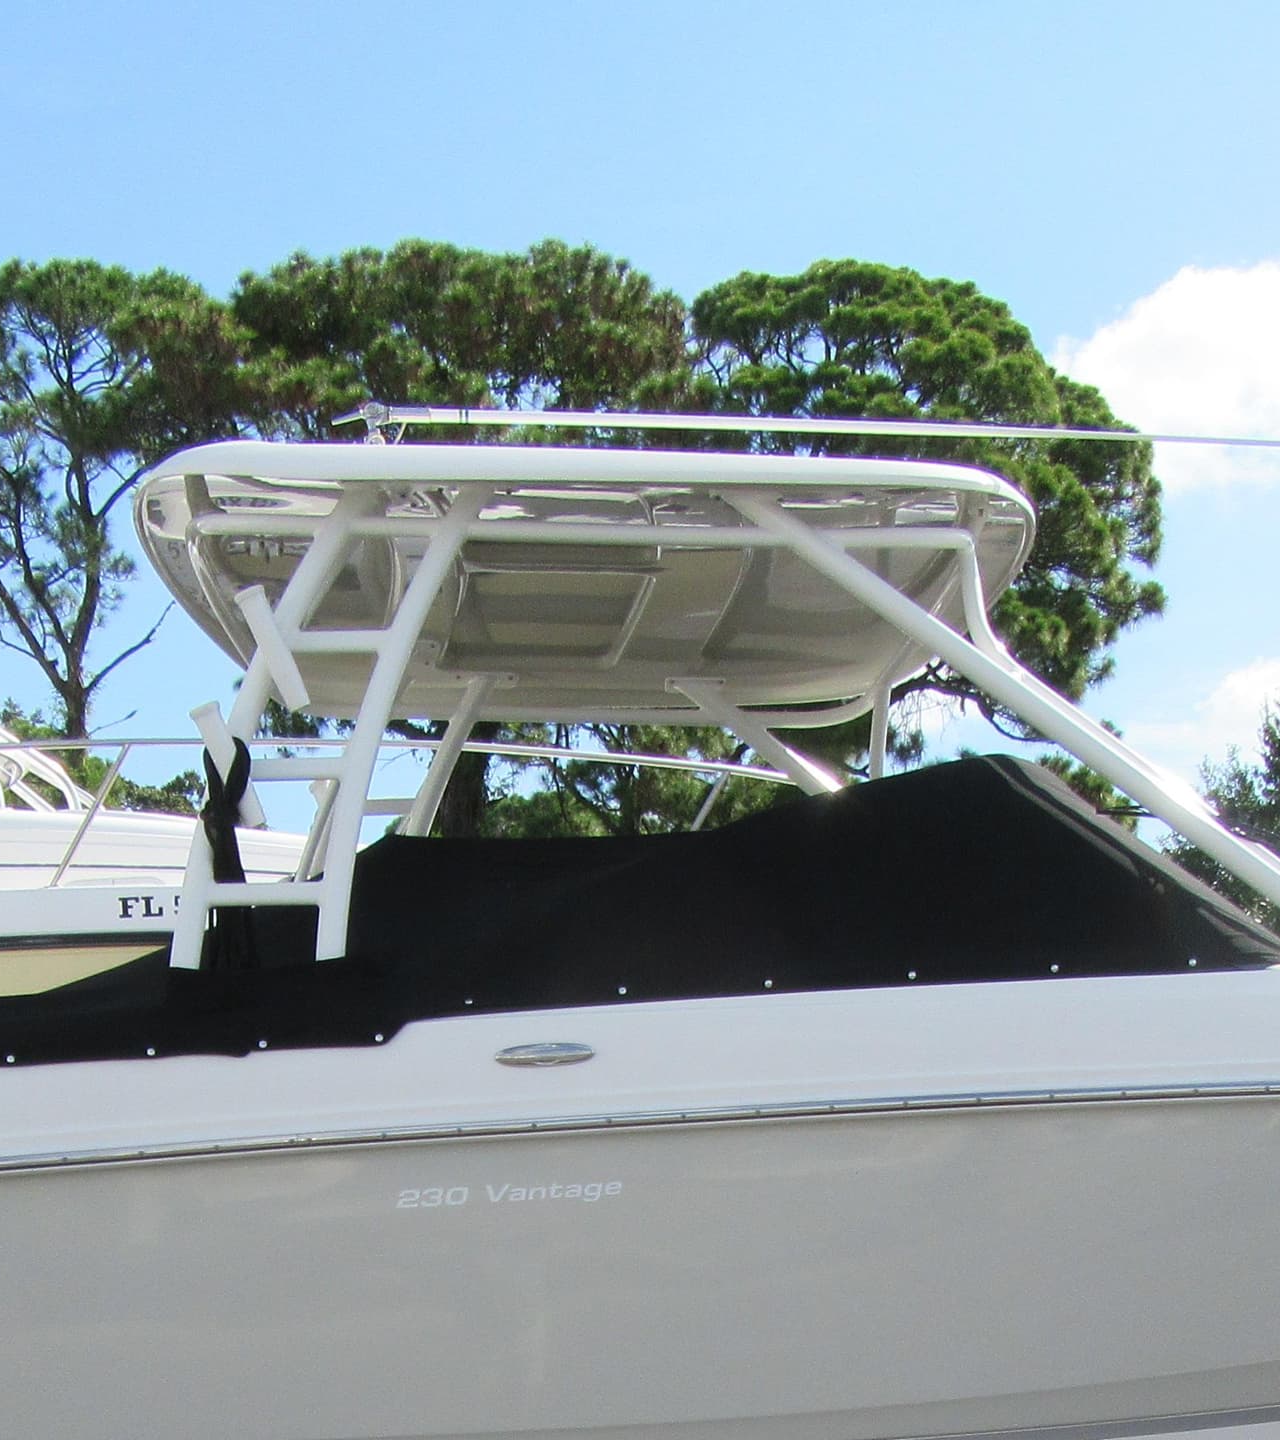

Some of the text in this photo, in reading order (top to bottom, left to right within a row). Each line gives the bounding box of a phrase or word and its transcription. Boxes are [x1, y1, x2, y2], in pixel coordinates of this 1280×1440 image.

[118, 895, 163, 918] FL
[396, 1181, 623, 1209] 230 Vantage
